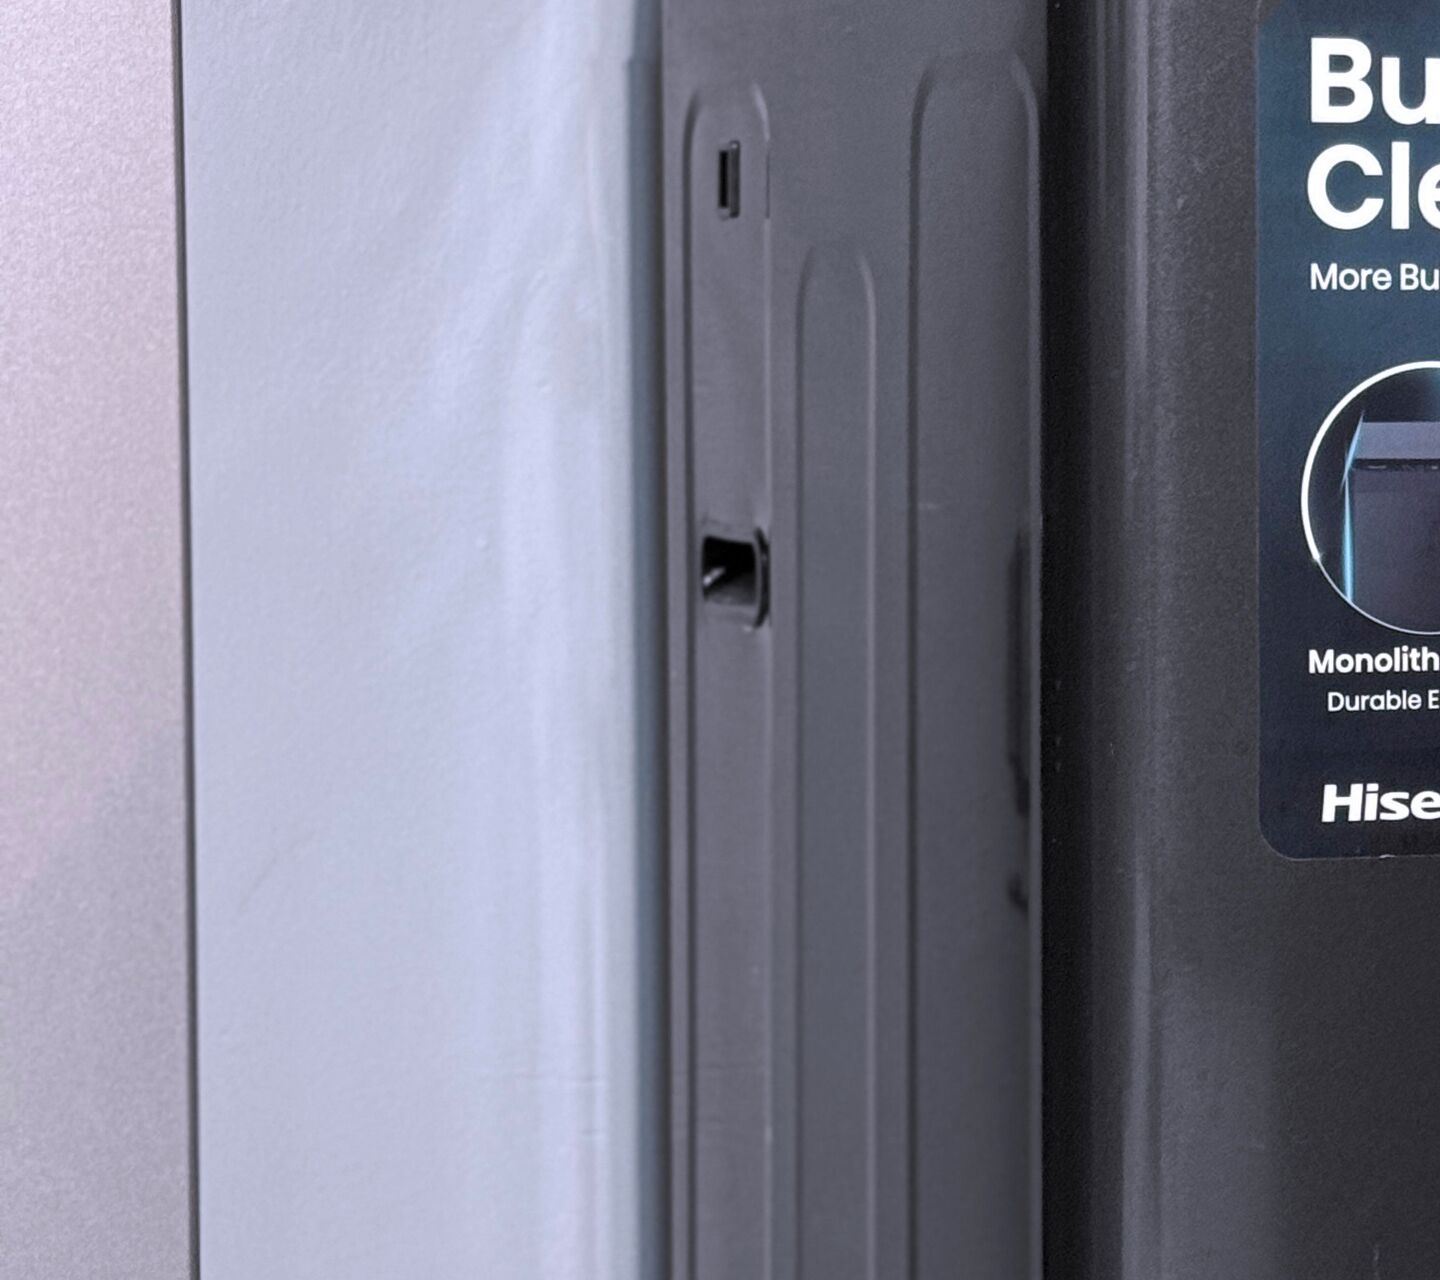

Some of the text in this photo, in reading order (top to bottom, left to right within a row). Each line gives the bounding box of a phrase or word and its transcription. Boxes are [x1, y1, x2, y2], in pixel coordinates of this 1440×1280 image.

[1310, 263, 1392, 291] More
[1308, 645, 1440, 674] Monolith
[1327, 689, 1421, 712] Durable
